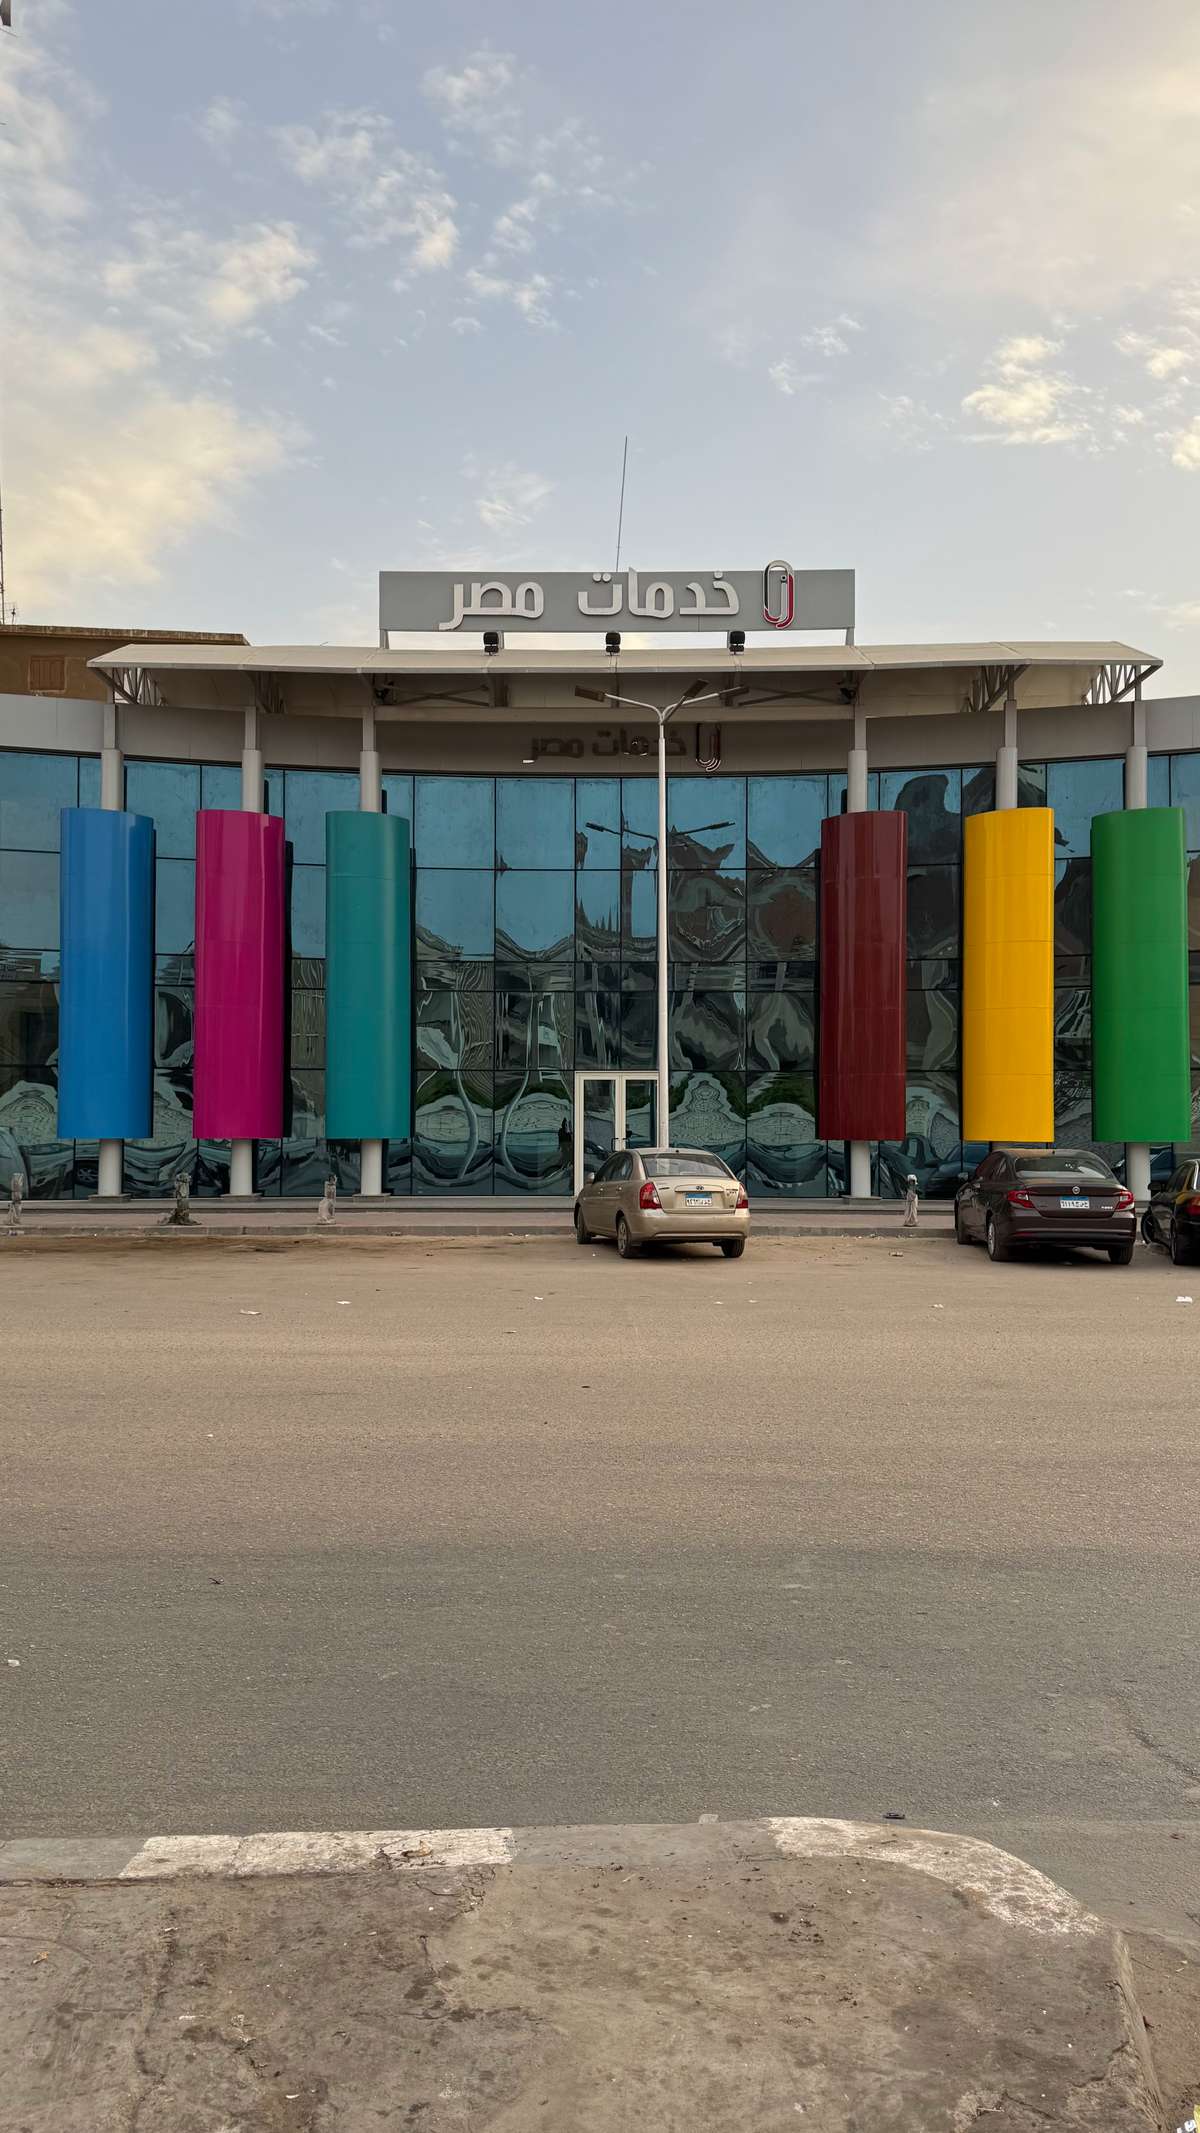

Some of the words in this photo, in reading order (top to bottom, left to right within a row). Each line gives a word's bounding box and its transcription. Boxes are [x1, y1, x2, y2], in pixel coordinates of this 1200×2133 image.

[438, 581, 545, 631] مصر
[577, 567, 740, 619] خدمات
[521, 736, 585, 764] مصر
